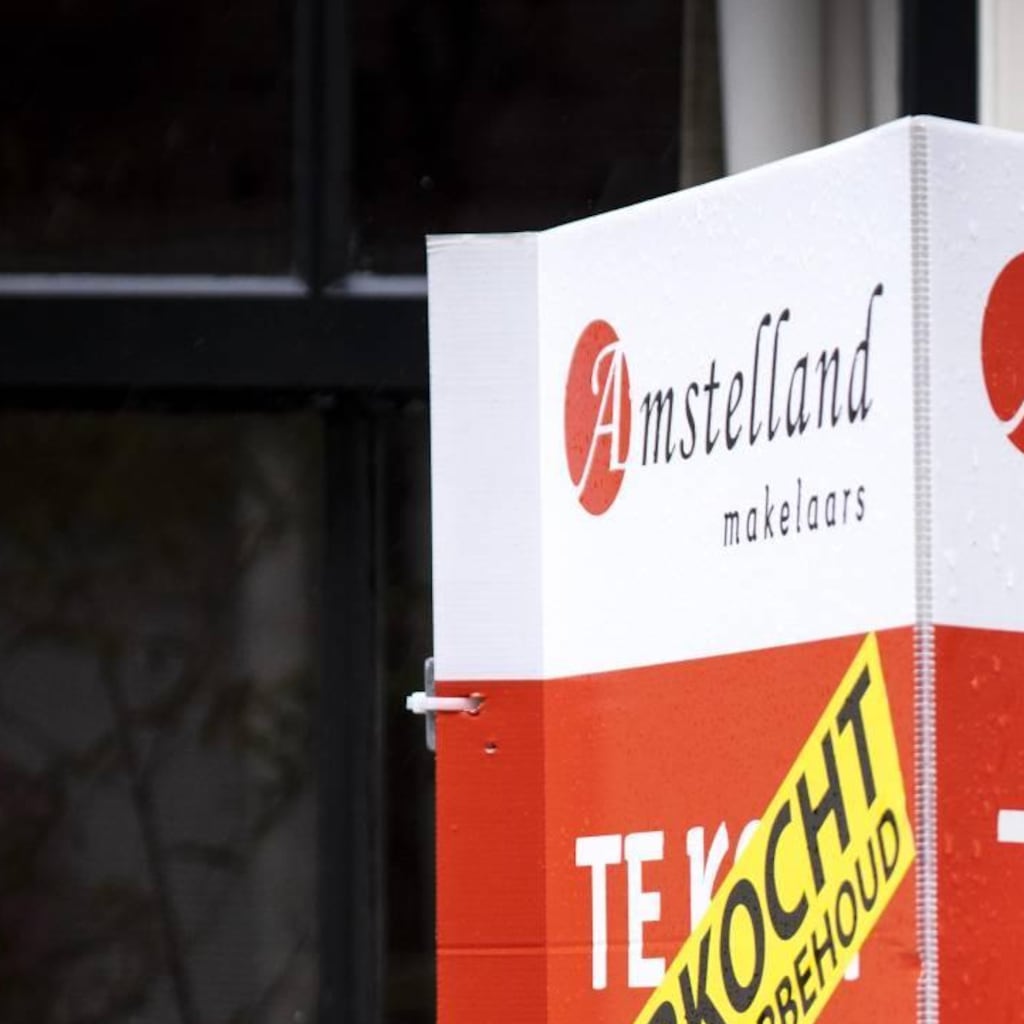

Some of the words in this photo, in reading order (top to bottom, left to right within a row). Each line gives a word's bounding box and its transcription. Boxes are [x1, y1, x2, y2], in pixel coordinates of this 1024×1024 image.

[575, 283, 884, 498] Amstelland
[723, 477, 865, 547] makelaars
[575, 831, 666, 990] TE
